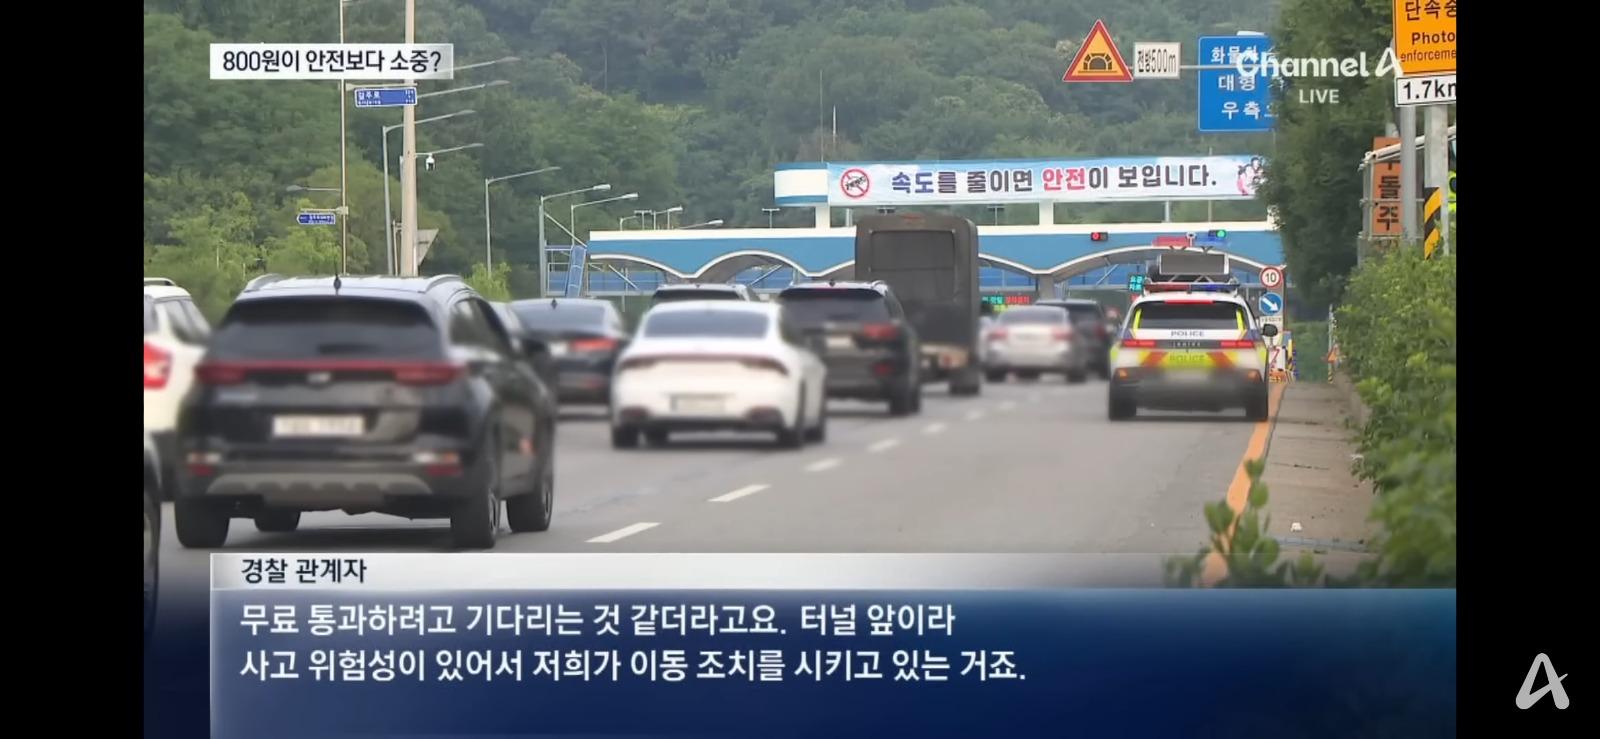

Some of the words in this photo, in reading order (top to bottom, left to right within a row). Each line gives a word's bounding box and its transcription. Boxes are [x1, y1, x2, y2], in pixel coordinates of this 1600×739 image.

[1411, 30, 1456, 45] Photo
[891, 171, 958, 194] 속도를
[966, 169, 1033, 193] 줄이면
[1042, 166, 1109, 191] 안전이
[1118, 164, 1217, 188] 보입니다.
[1265, 272, 1277, 283] 10
